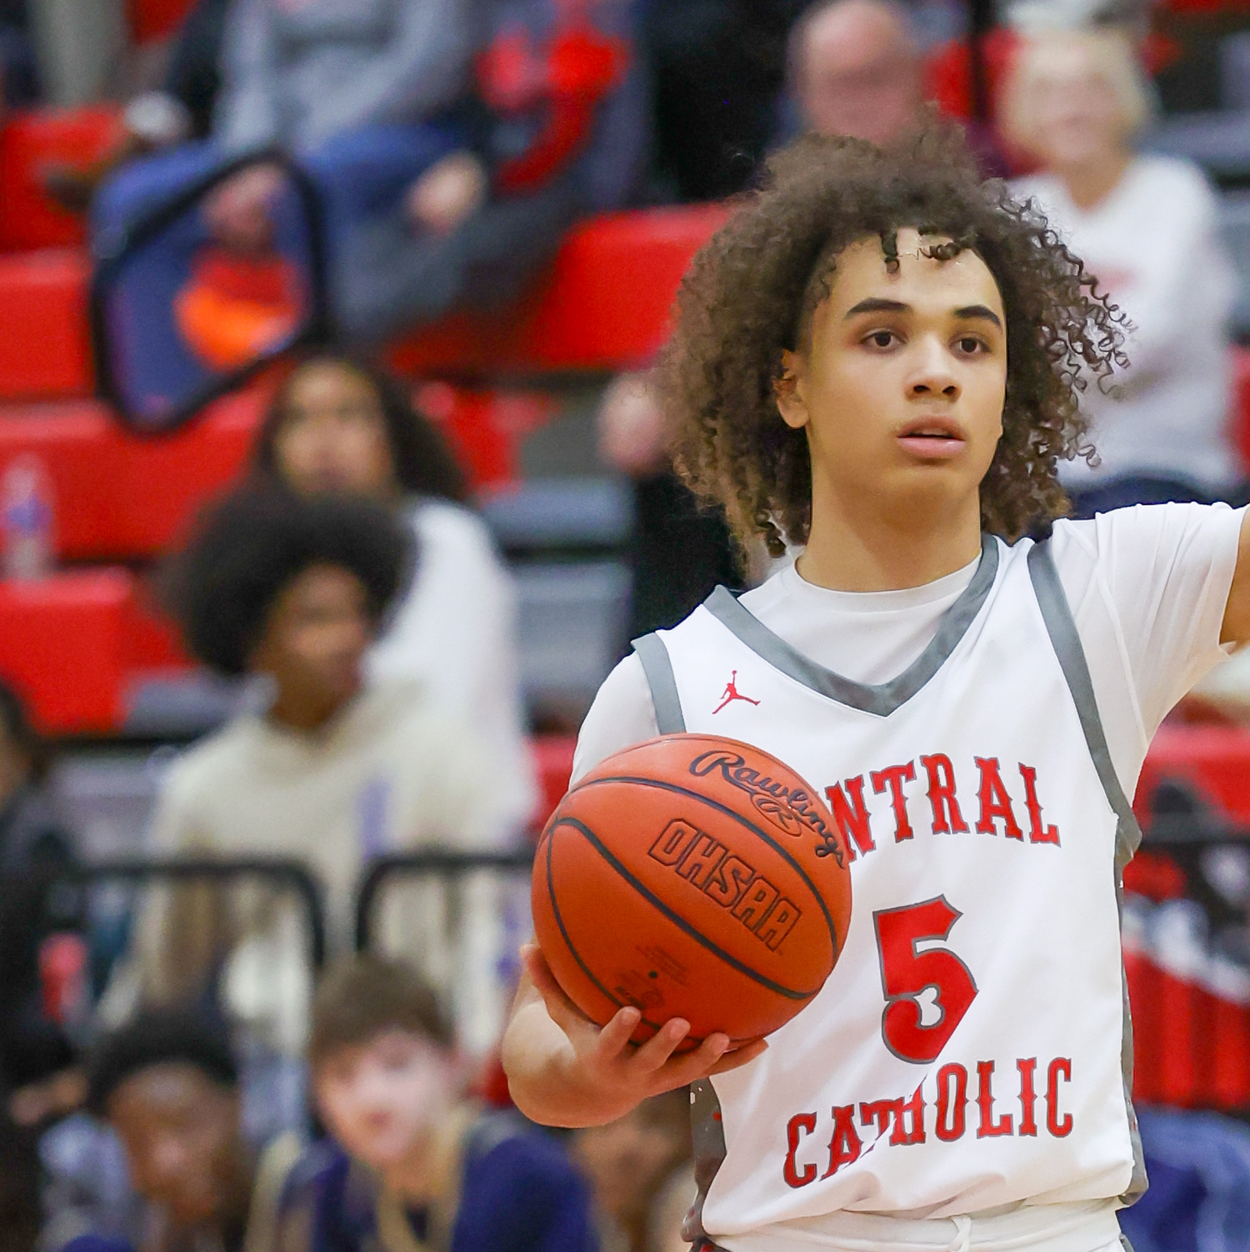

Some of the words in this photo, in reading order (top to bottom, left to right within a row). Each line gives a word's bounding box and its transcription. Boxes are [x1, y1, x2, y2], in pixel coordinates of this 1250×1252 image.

[689, 749, 845, 869] Rawlings
[824, 752, 1062, 864] NTRAL
[648, 818, 802, 952] OHSAA
[873, 894, 979, 1064] 5
[783, 1056, 1073, 1188] CATHOLIC
